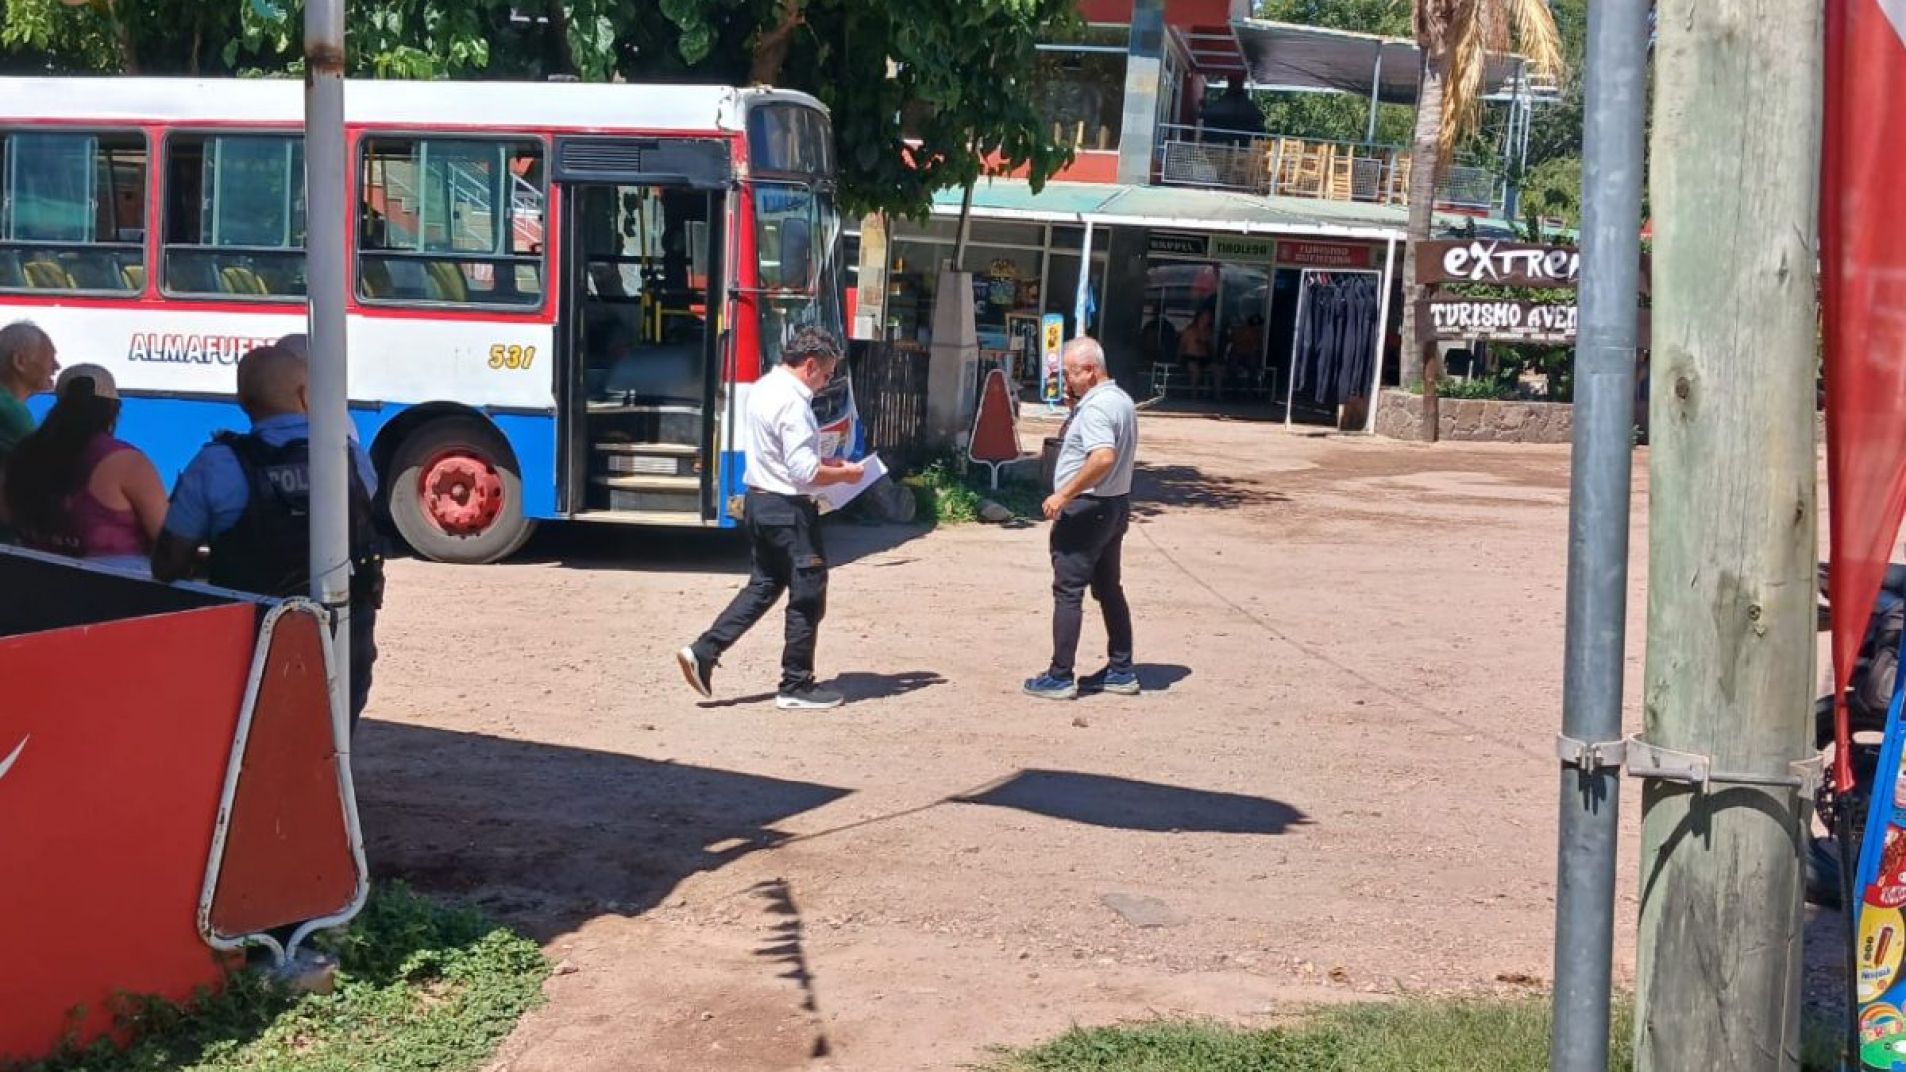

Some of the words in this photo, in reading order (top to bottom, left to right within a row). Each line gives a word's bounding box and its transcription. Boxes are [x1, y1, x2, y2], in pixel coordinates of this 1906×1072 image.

[1430, 302, 1522, 328] TURISMO
[1527, 304, 1578, 329] AVEN
[488, 344, 537, 370] 531
[268, 467, 309, 493] POL
